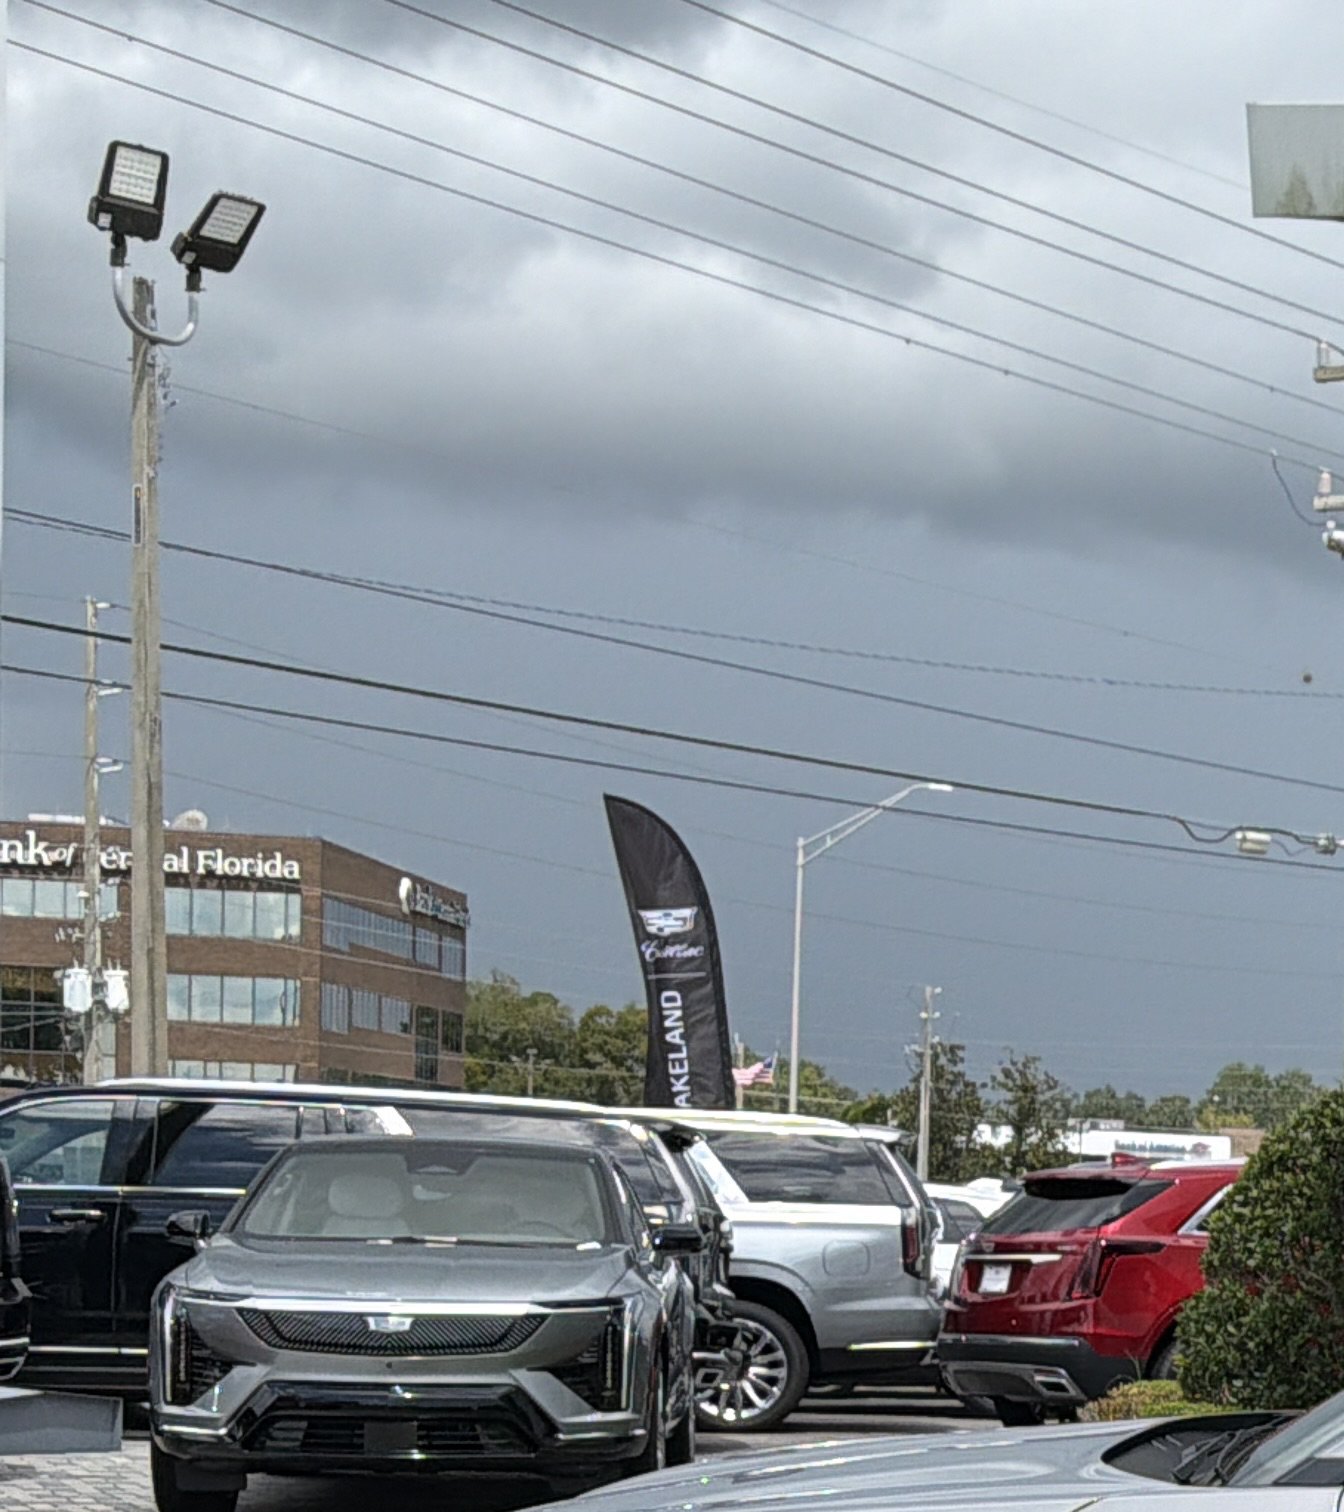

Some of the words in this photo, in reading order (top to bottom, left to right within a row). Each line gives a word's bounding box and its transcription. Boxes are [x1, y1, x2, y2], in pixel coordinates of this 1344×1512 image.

[0, 829, 52, 866] nk
[55, 842, 78, 867] of
[196, 848, 300, 880] Florida
[661, 990, 692, 1108] AKELAND
